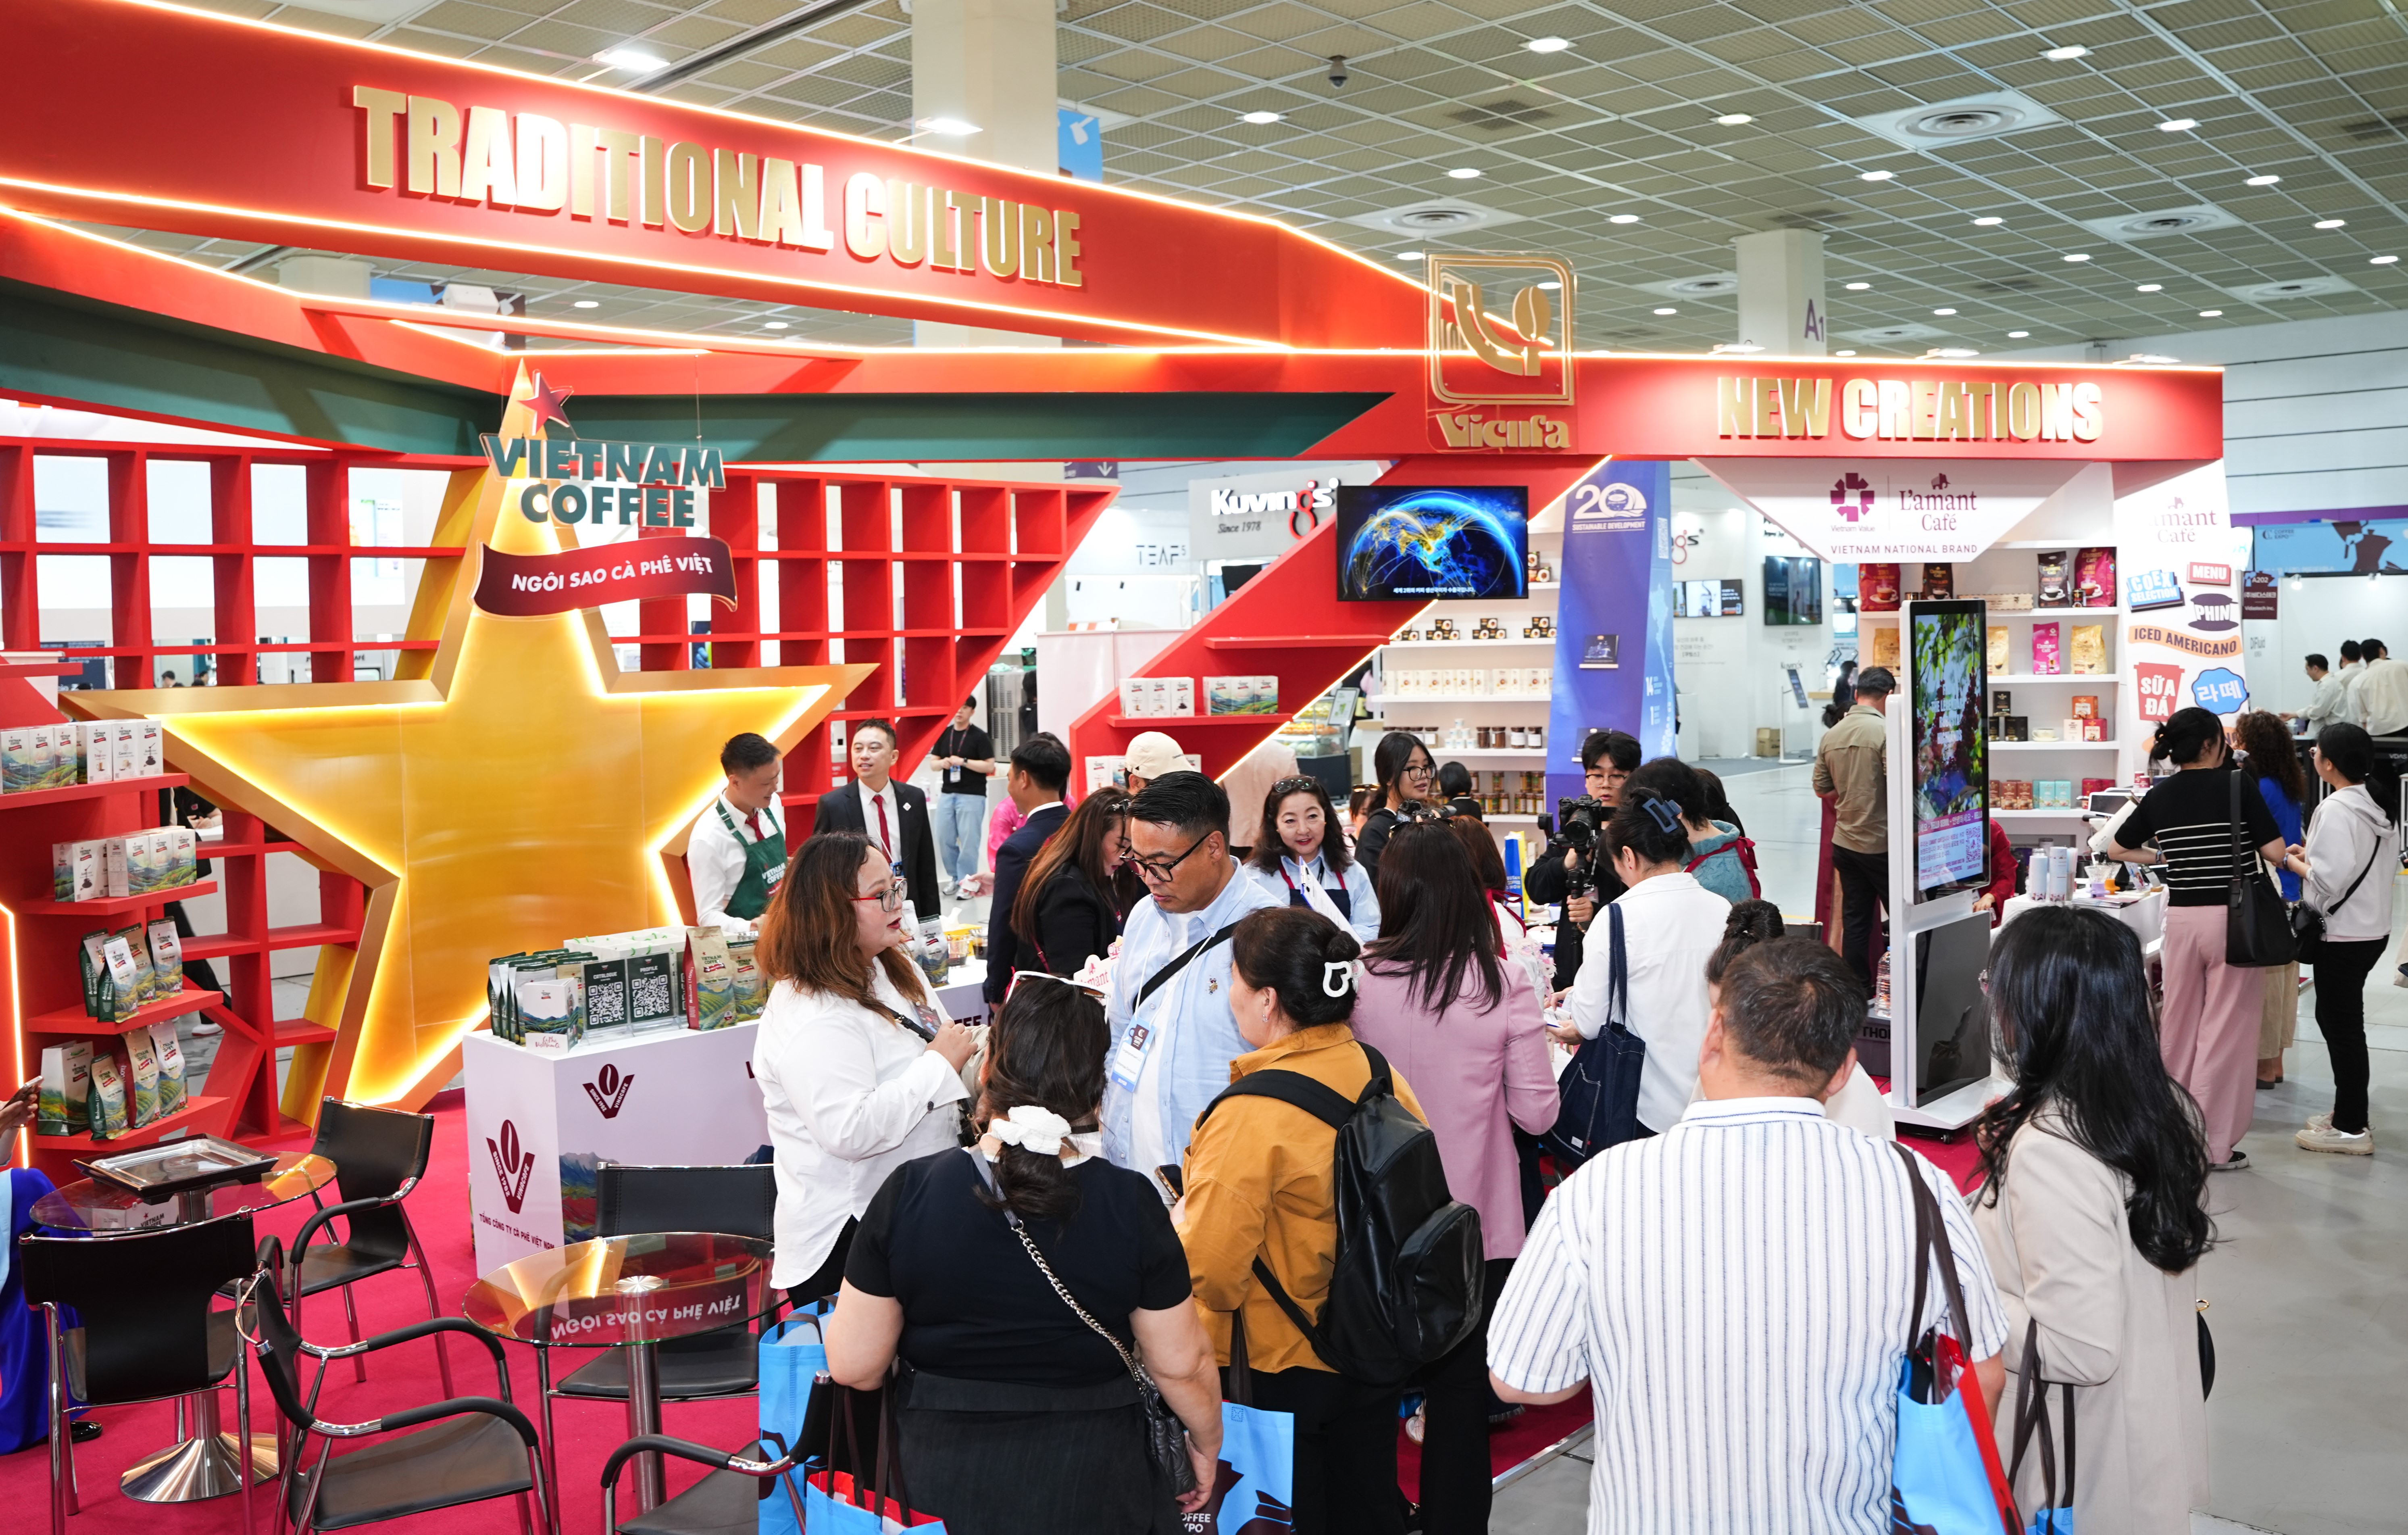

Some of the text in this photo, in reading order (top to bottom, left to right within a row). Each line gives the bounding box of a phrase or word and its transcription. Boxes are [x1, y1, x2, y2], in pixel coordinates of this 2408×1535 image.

[354, 86, 1082, 287] TRADITIONAL CULTURE
[1717, 377, 2103, 440] NEW CREATIONS
[484, 436, 725, 488] VIETNAM
[521, 484, 695, 527] COFFEE
[1211, 478, 1339, 540] Kuvings
[1900, 489, 1977, 511] L'amant
[1218, 521, 1261, 534] Since 1978
[1572, 521, 1646, 531] SUSTAINABLE DEVELOPMENT
[1921, 515, 1957, 532] Café
[2158, 528, 2196, 543] Café
[1831, 545, 1977, 554] VIETNAM NATIONAL BRAND
[512, 553, 713, 592] NGÔI SAO CÀ PHÊ VIỆT
[2131, 570, 2173, 592] COEX
[2193, 565, 2227, 580] MENU
[2131, 587, 2178, 602] SELECTION
[2194, 605, 2230, 621] PHIN
[2135, 628, 2237, 655] ICED AMERICANO
[2140, 675, 2176, 697] SỮA
[2196, 680, 2242, 702] 라떼
[2145, 695, 2169, 717] ĐÁ
[762, 862, 786, 879] VIETNAM
[590, 1089, 607, 1112] SINCE 1982
[614, 1082, 629, 1108] VINACAFE
[493, 1151, 510, 1197] SINCE 1982
[516, 1163, 530, 1200] VINACAFE
[141, 1213, 165, 1227] VIETNAM
[479, 1210, 555, 1250] TỔNG CÔNG TY CÀ PHÊ VIỆT NAM
[1181, 1512, 1211, 1523] OFFEE
